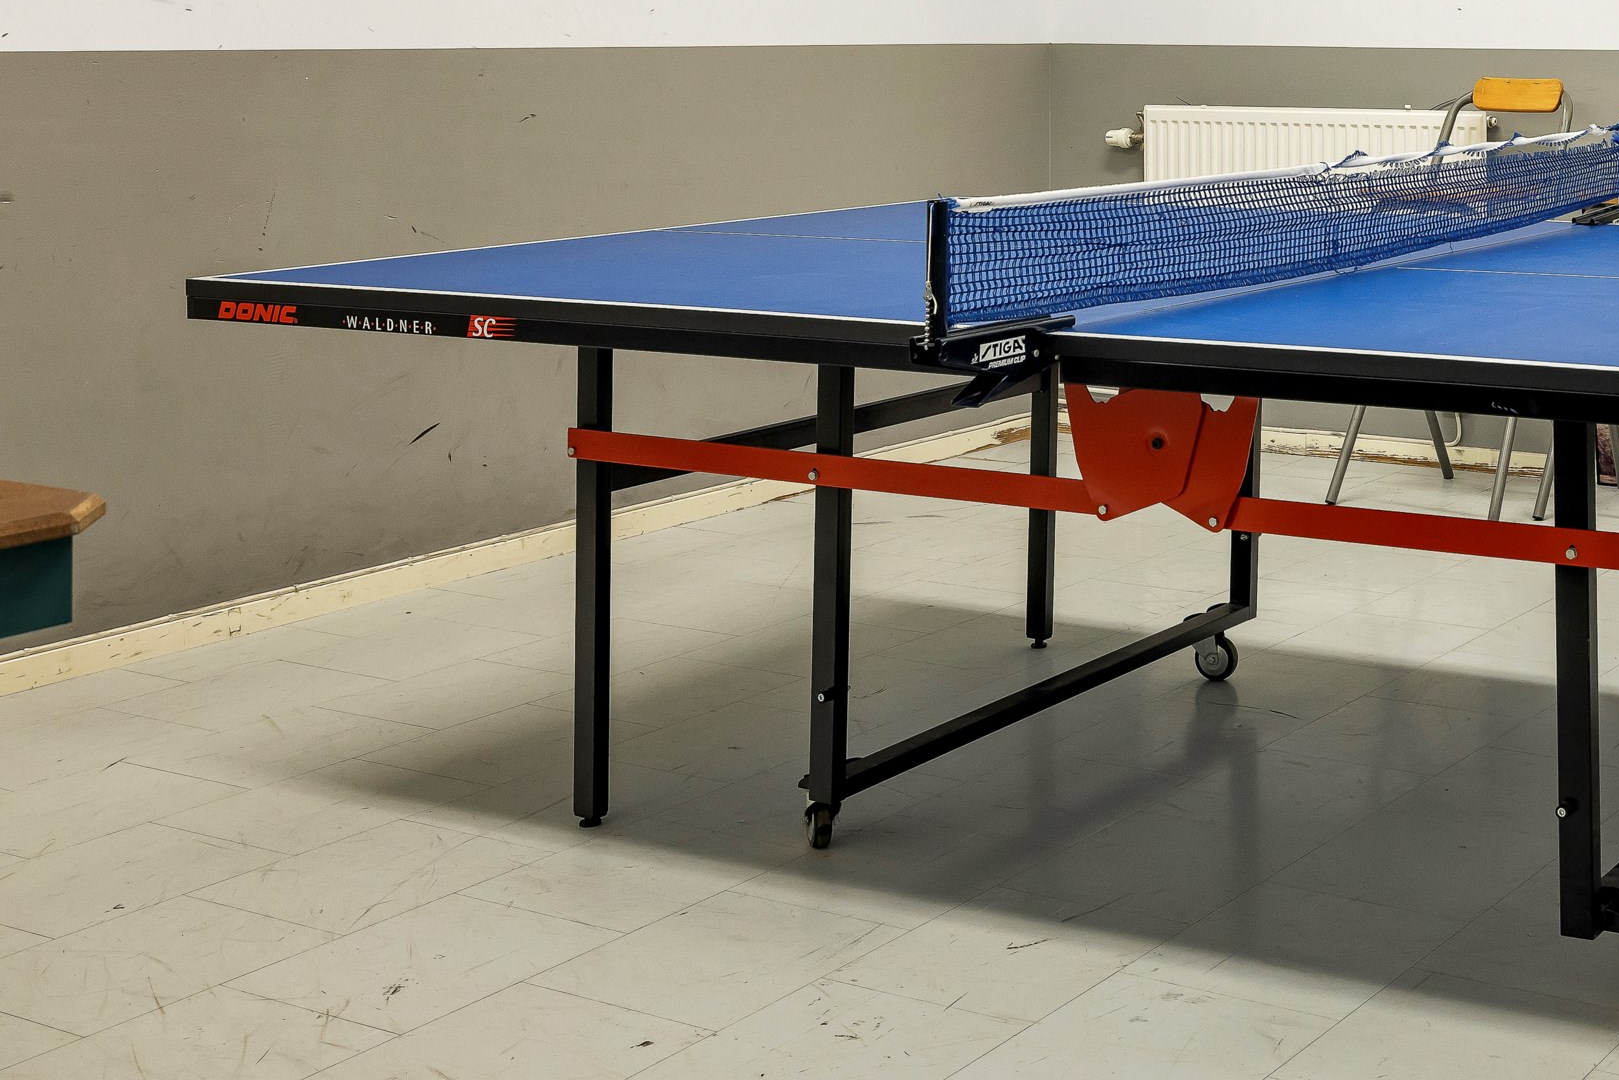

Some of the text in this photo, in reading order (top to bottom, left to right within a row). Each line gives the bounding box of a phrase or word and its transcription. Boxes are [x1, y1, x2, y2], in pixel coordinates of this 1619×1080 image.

[218, 301, 297, 323] DONIC
[472, 317, 496, 338] SC
[981, 339, 1023, 359] STIGA
[988, 354, 1026, 369] PREMIUM CLIP
